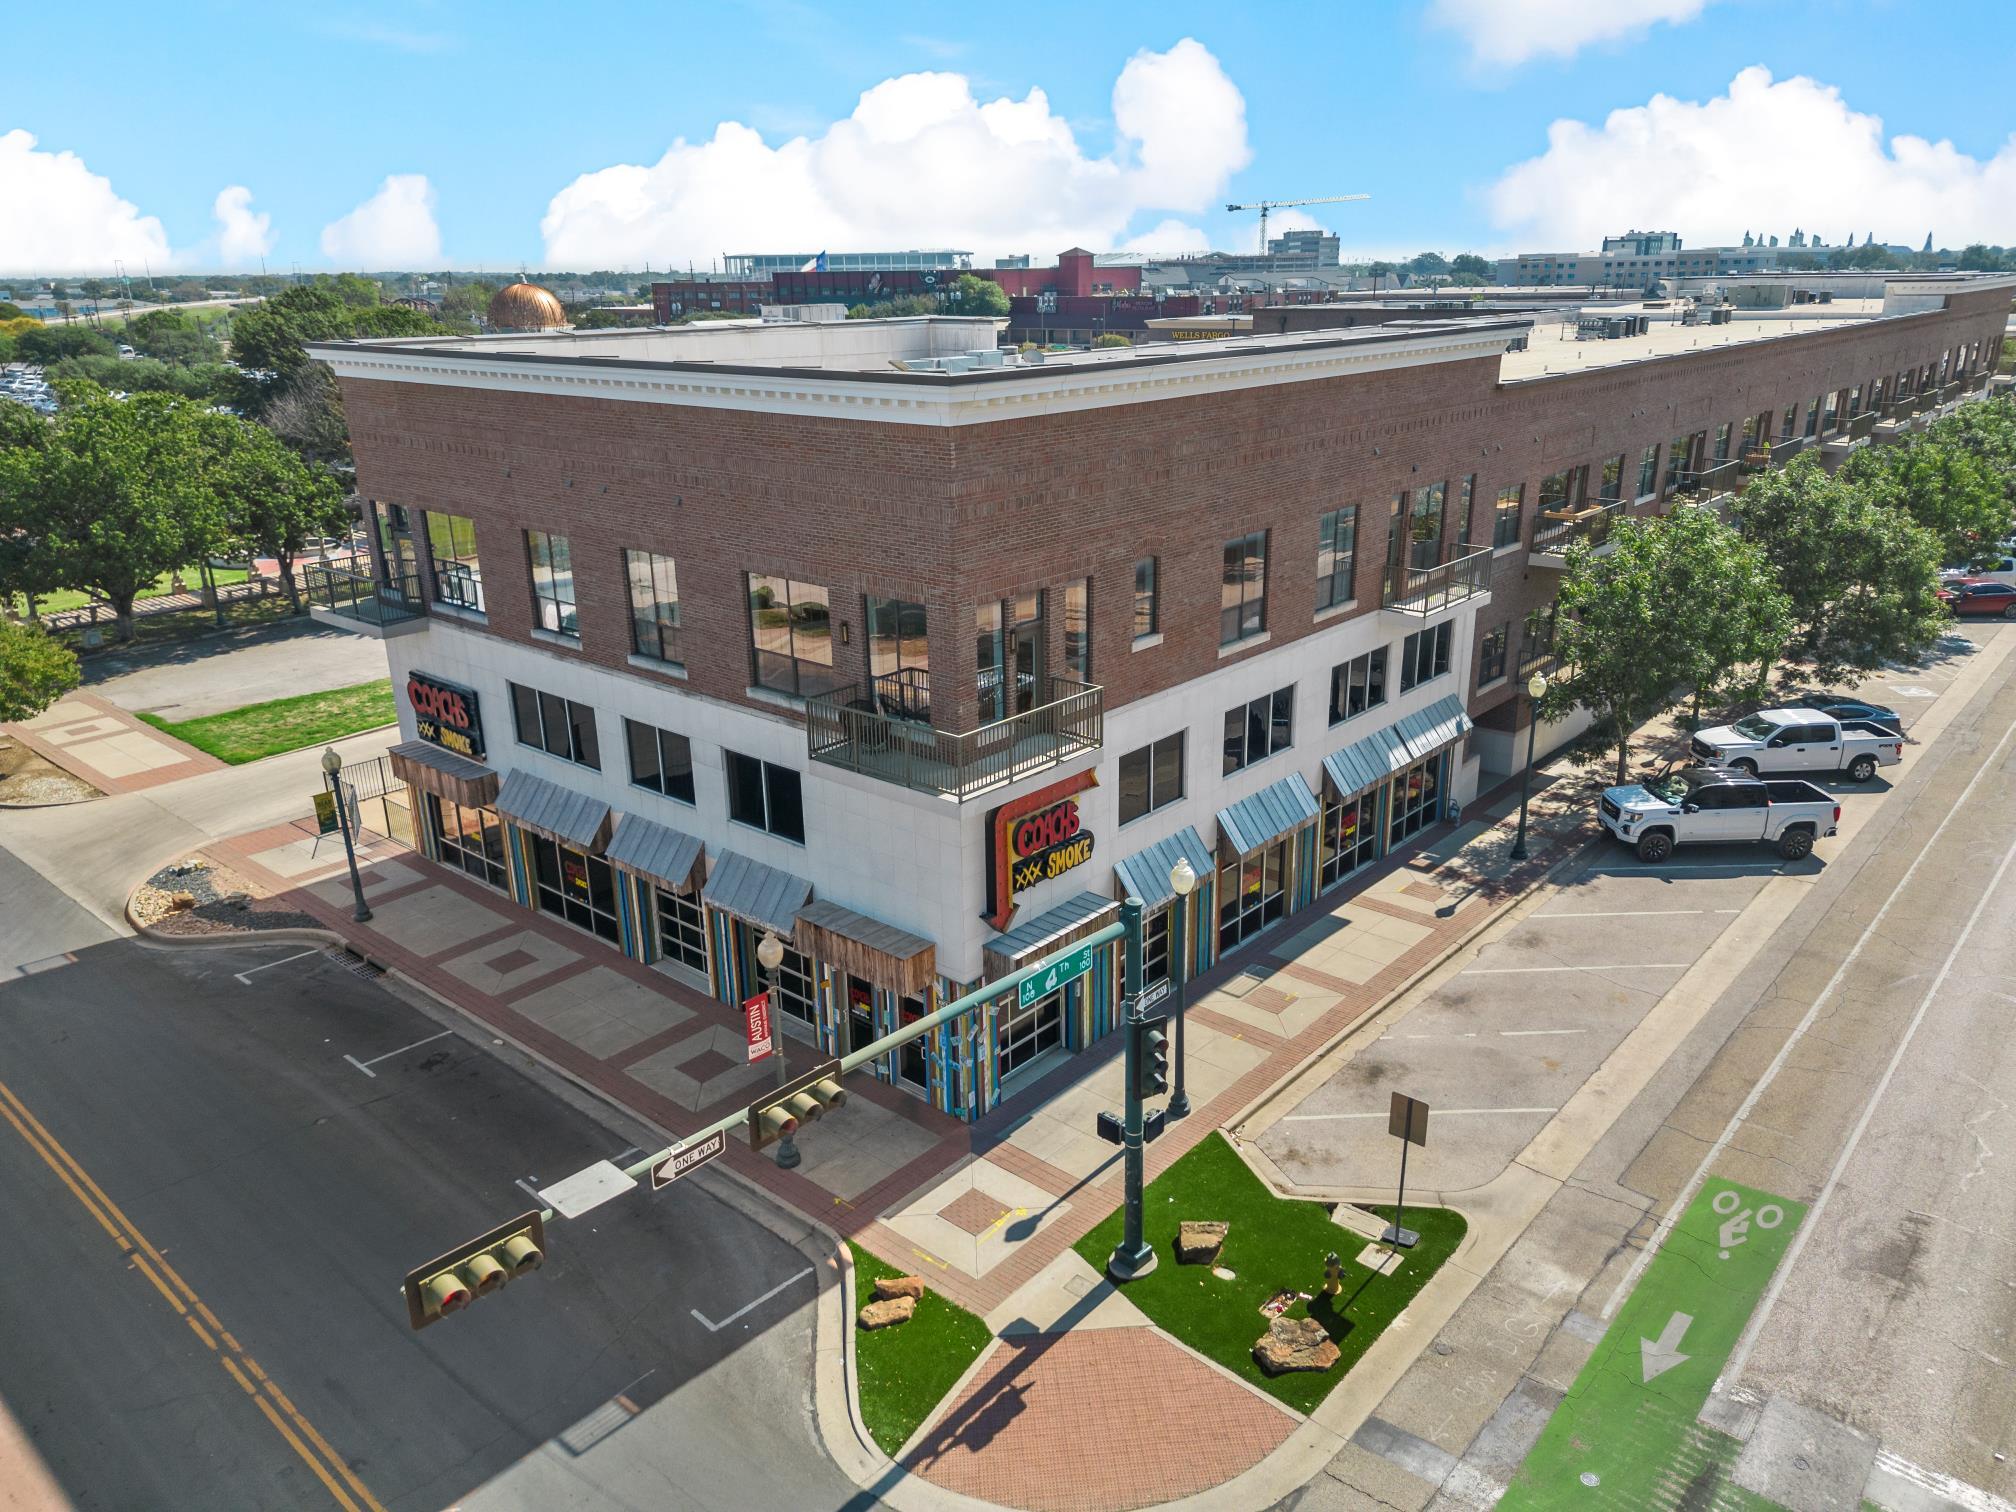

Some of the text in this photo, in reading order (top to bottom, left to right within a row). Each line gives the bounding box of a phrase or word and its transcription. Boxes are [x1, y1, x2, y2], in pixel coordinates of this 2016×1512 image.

[1171, 331, 1231, 339] WELLS FARGO
[441, 726, 472, 755] SMOKE
[1047, 838, 1091, 879] SMOKE
[1026, 949, 1090, 992] N 4 Th St
[749, 1004, 762, 1041] AUSTIN
[750, 1042, 771, 1055] WACO
[674, 1139, 717, 1170] ONE WAY
